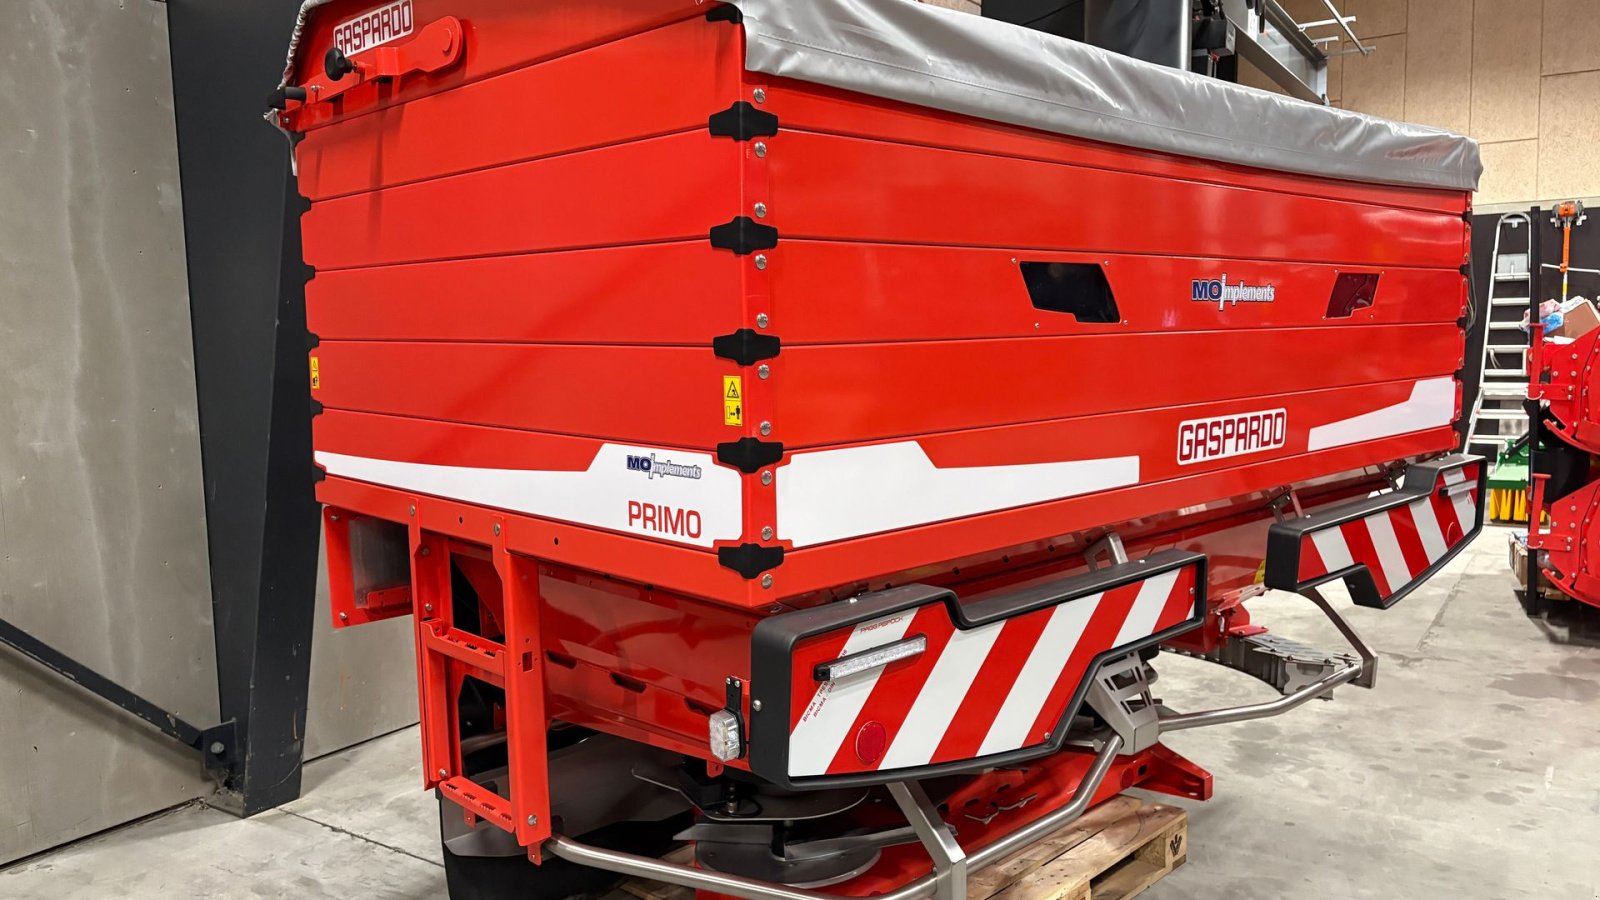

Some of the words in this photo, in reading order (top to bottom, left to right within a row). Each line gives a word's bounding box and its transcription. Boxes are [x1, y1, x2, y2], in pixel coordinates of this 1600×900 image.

[334, 0, 412, 55] GASPARDO
[1179, 411, 1286, 461] GASPARDO
[628, 500, 702, 539] PRIMO
